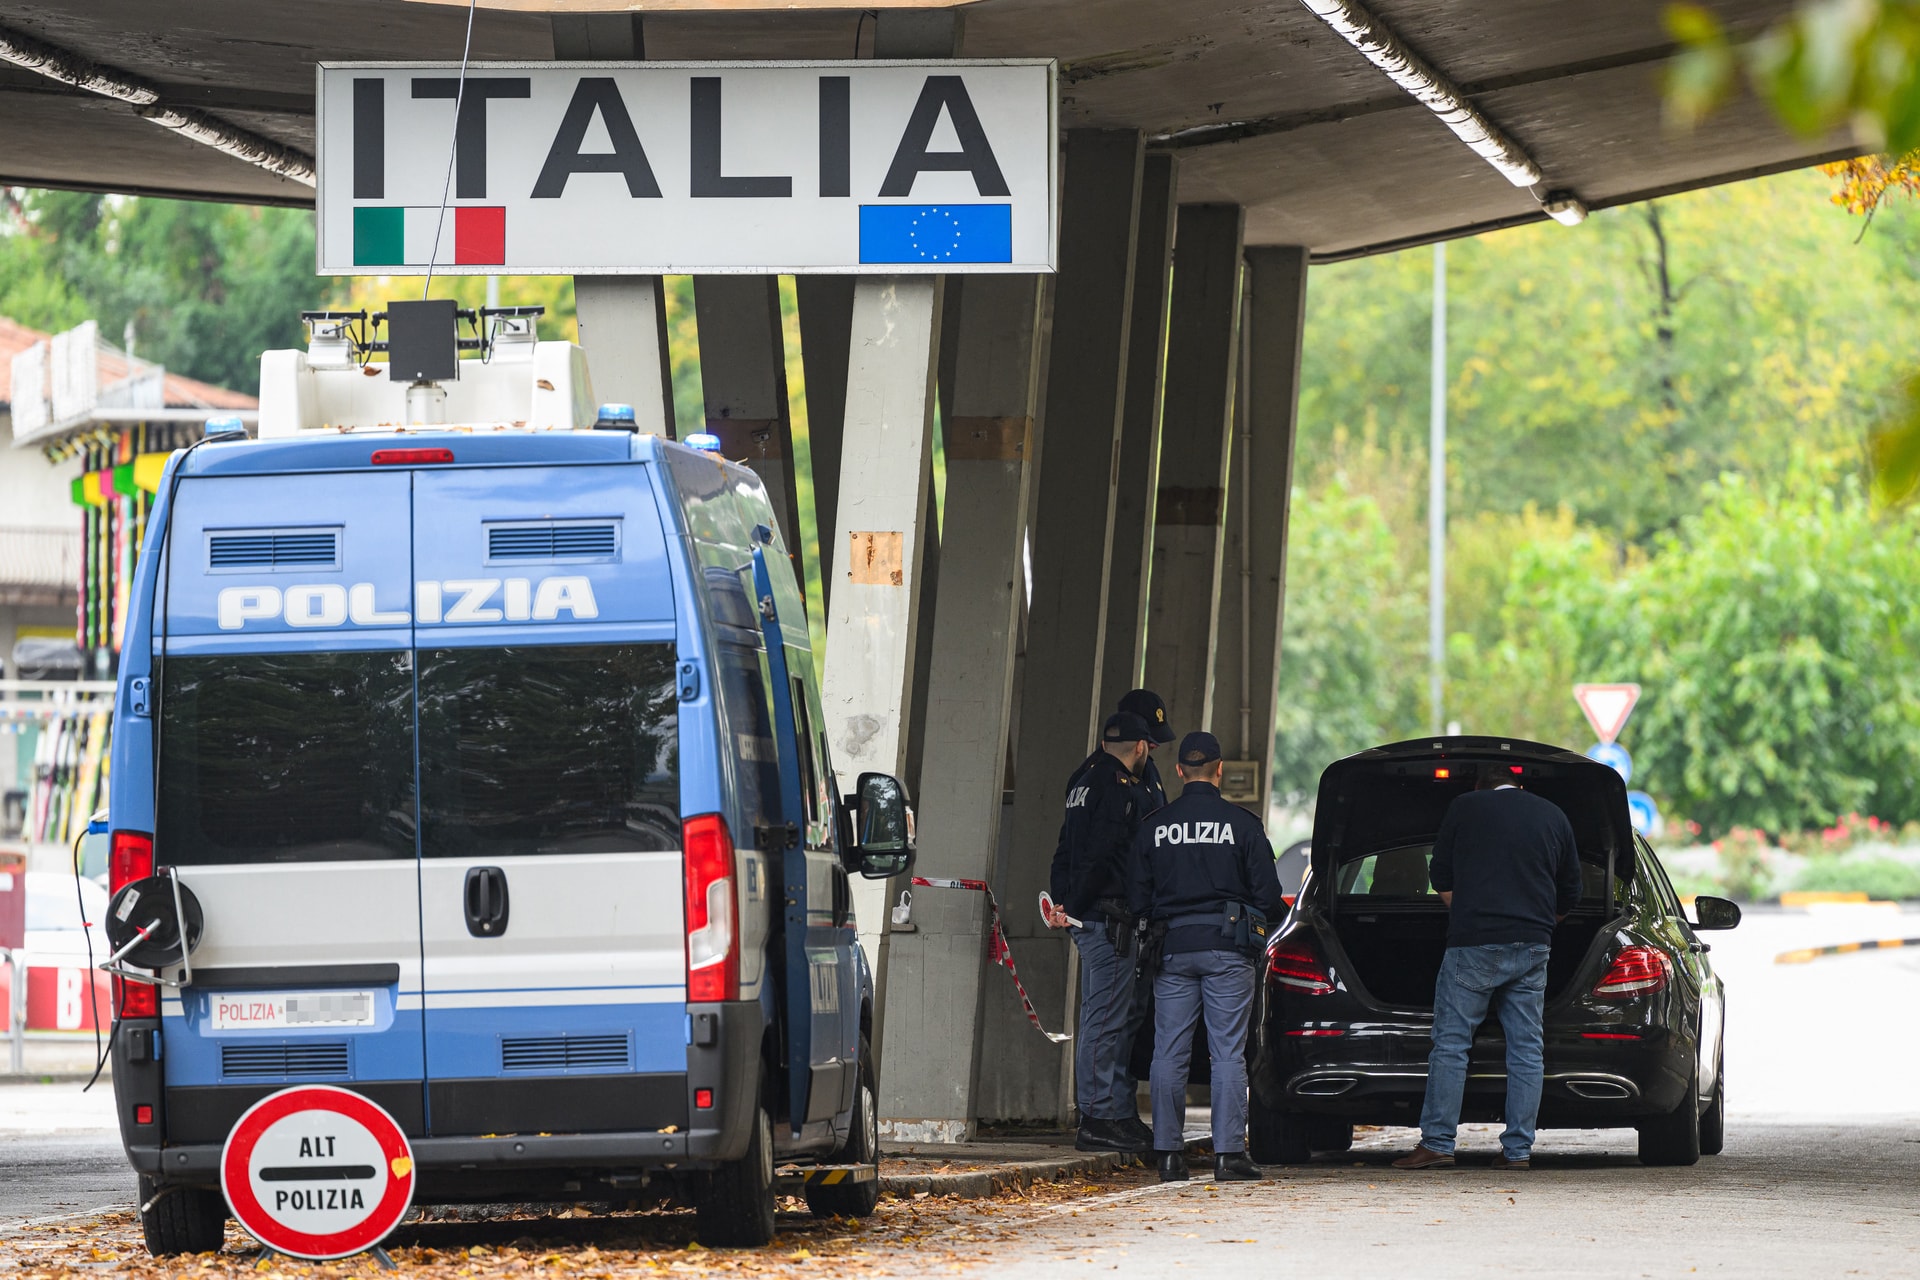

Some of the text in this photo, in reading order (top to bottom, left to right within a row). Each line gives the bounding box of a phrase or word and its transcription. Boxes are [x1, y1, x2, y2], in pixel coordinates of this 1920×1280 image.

[353, 75, 1012, 199] ITALIA
[217, 576, 599, 630] POLIZIA
[1154, 821, 1235, 848] POLIZIA
[219, 1003, 275, 1021] POLIZIA
[299, 1136, 336, 1158] ALT
[275, 1188, 364, 1211] POLIZIA
